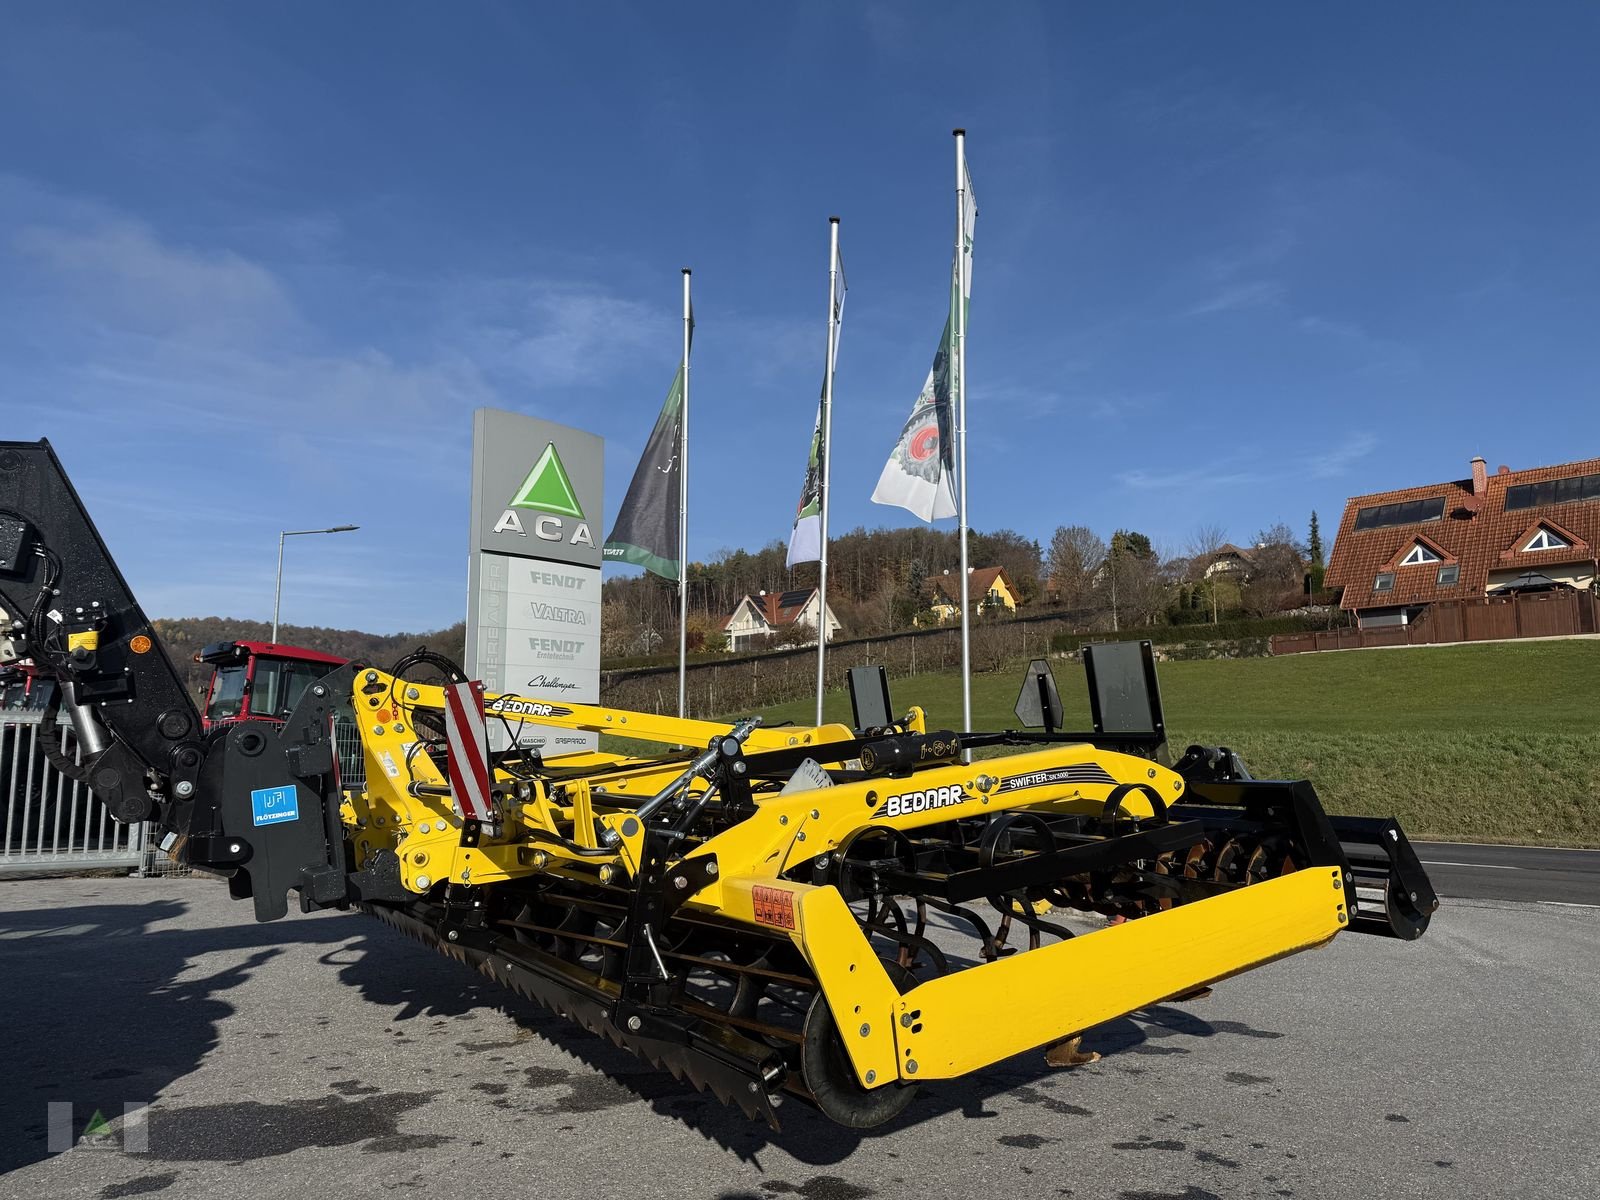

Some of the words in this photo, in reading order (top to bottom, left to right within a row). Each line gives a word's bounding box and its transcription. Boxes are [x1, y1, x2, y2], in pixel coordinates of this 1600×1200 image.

[492, 509, 596, 549] ACA
[530, 571, 586, 590] FENDT
[530, 602, 586, 625] VALTRA
[528, 638, 585, 653] FENDT
[528, 674, 582, 693] Challenger
[492, 699, 553, 717] BEDNAR
[1010, 773, 1048, 789] SWIFTER
[886, 785, 964, 817] BEDNAR
